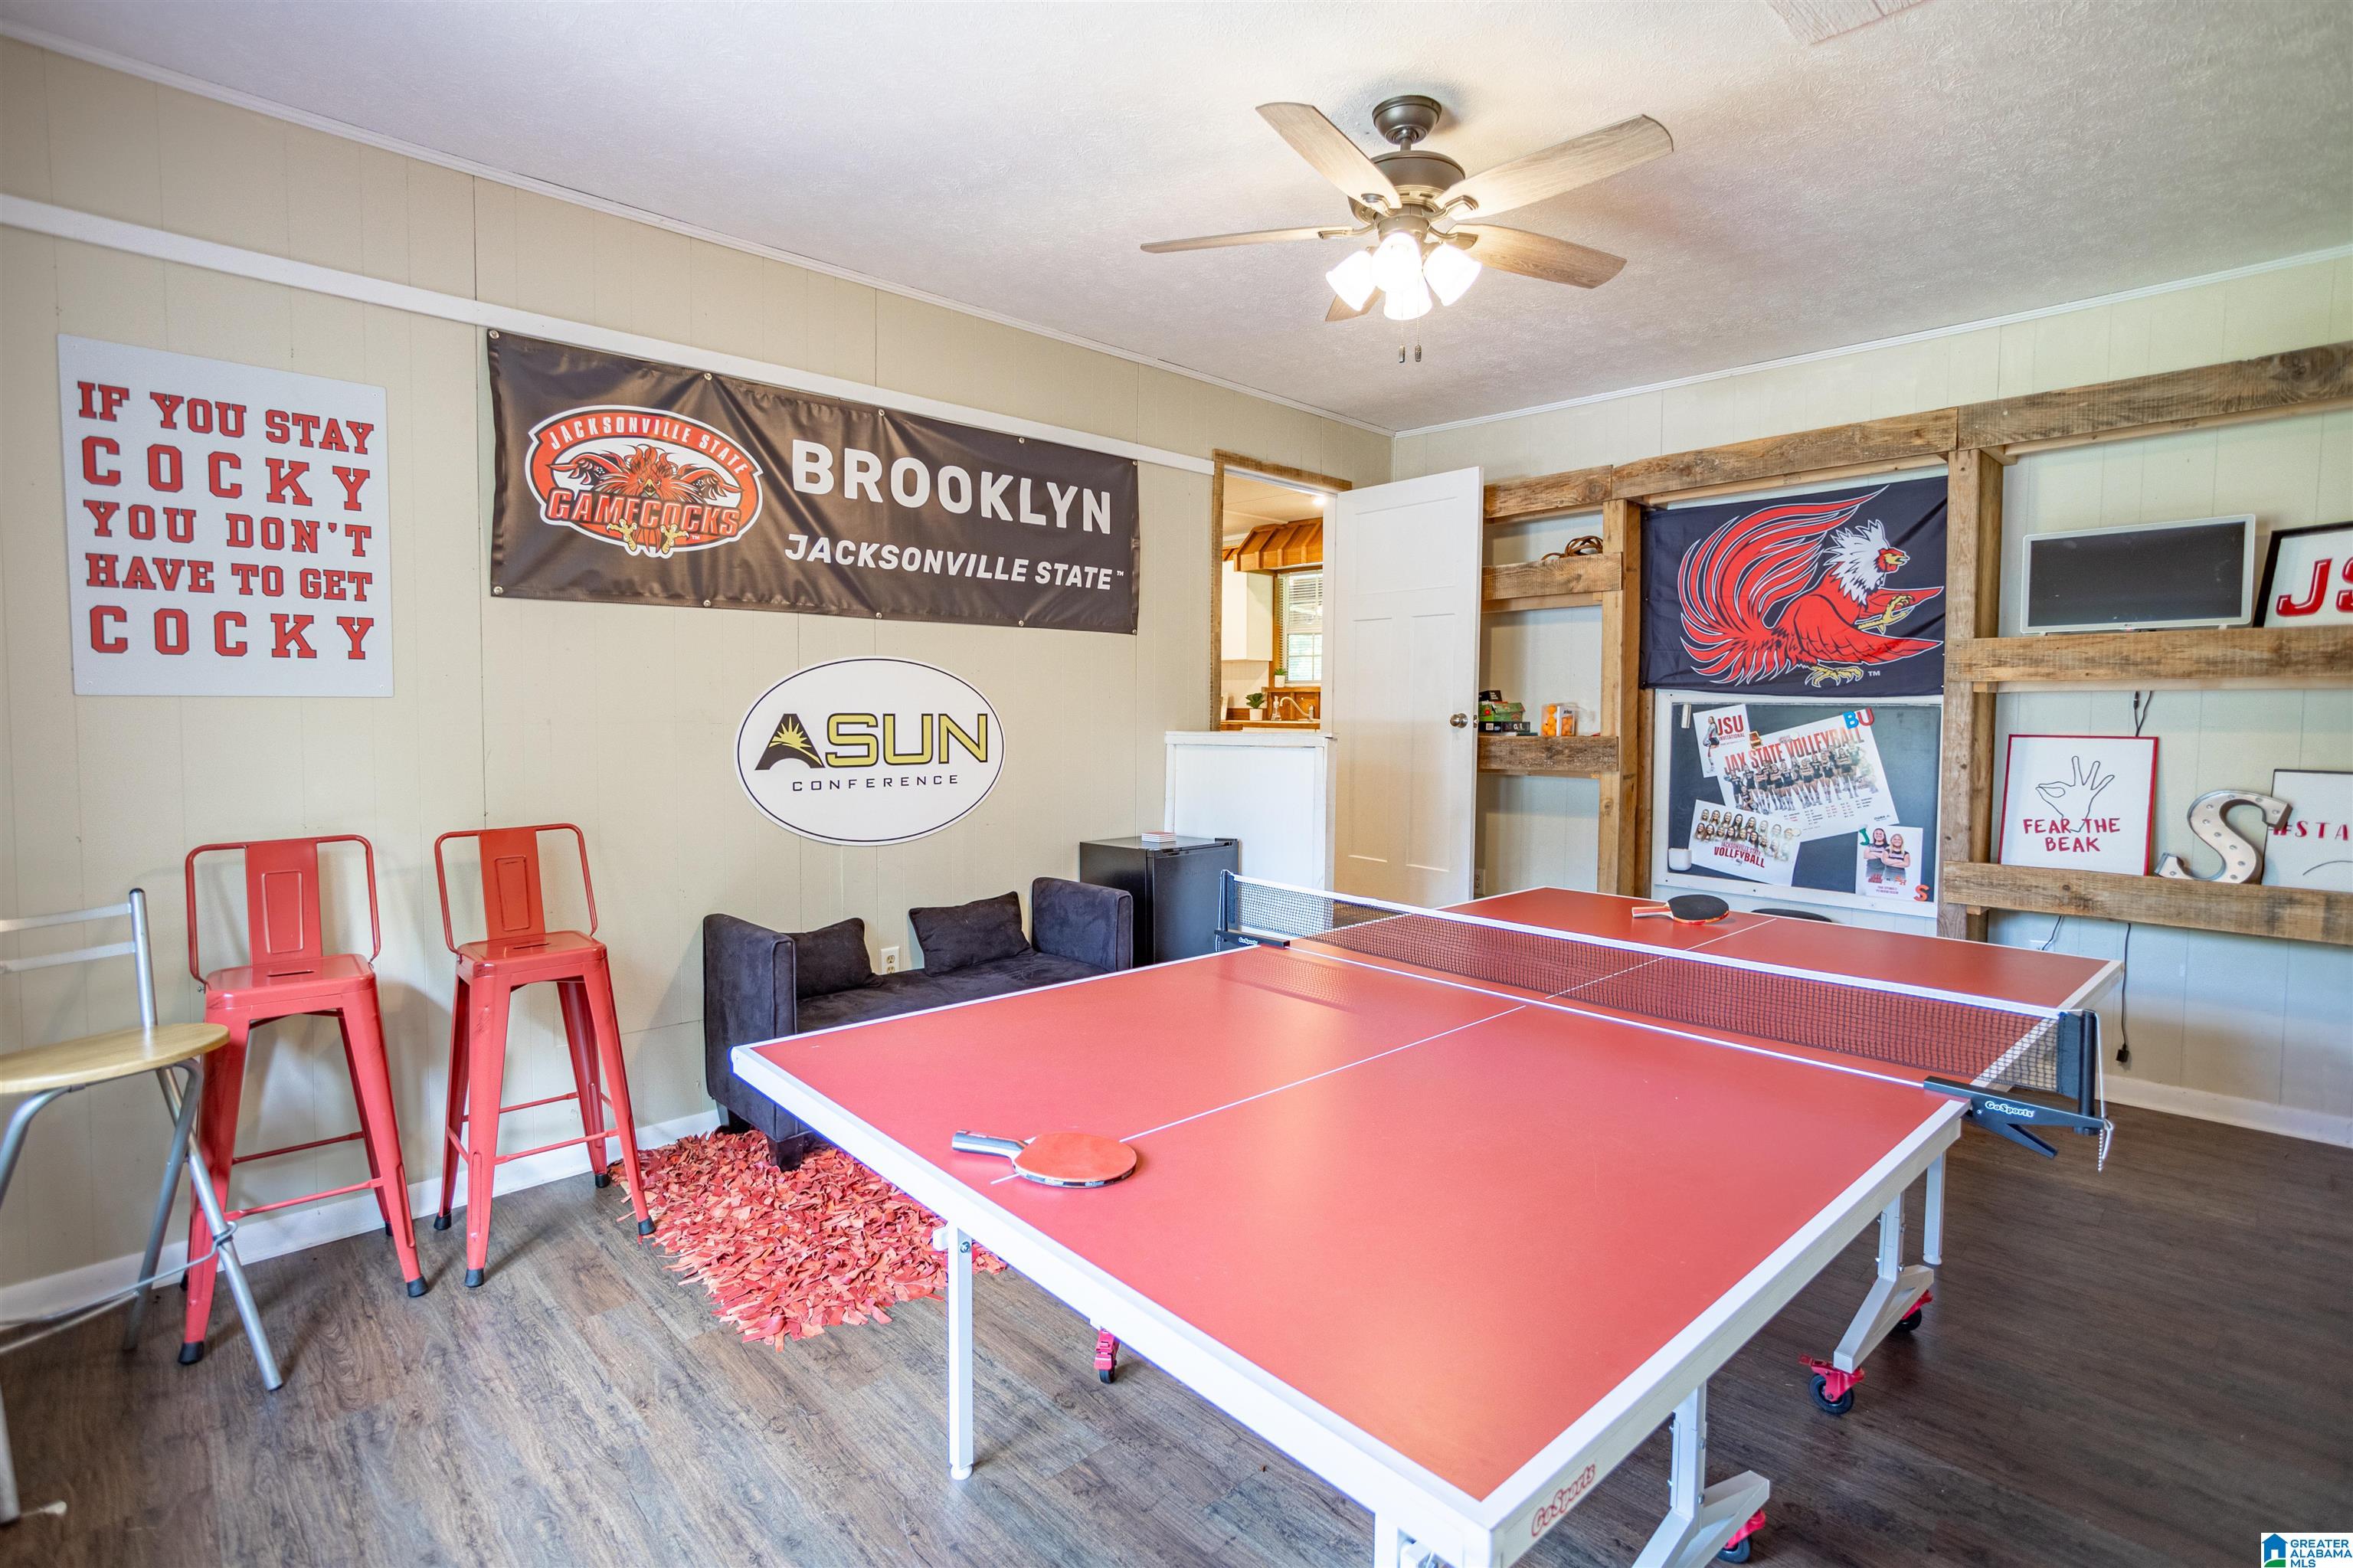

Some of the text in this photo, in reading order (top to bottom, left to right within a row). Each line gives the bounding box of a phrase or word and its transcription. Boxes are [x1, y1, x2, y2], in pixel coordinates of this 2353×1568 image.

[77, 381, 374, 455] IF YOU STAY
[550, 417, 748, 474] JACKSONVILLE STATE
[82, 435, 371, 511] COCKY
[792, 439, 1111, 535] BROOKLYN
[83, 499, 371, 557] YOU DON'T
[545, 488, 743, 537] GAMECOCKS
[85, 553, 372, 602] HAVE TO GET
[784, 534, 1029, 582] JACKSONVILLE
[1035, 561, 1113, 590] STATE
[90, 605, 374, 660] COCKY
[754, 713, 988, 771] ASUN
[1717, 715, 1744, 736] JSU
[1724, 727, 1864, 775] JAX STATE VOLLEYBALL
[792, 774, 958, 791] CONFERENCE
[2023, 817, 2120, 834] FEAR THE
[2045, 837, 2100, 853] BEAK
[1714, 846, 1765, 868] VOLLEYBALL
[1985, 1101, 2034, 1118] GoSports
[1531, 1464, 1596, 1537] GoSports
